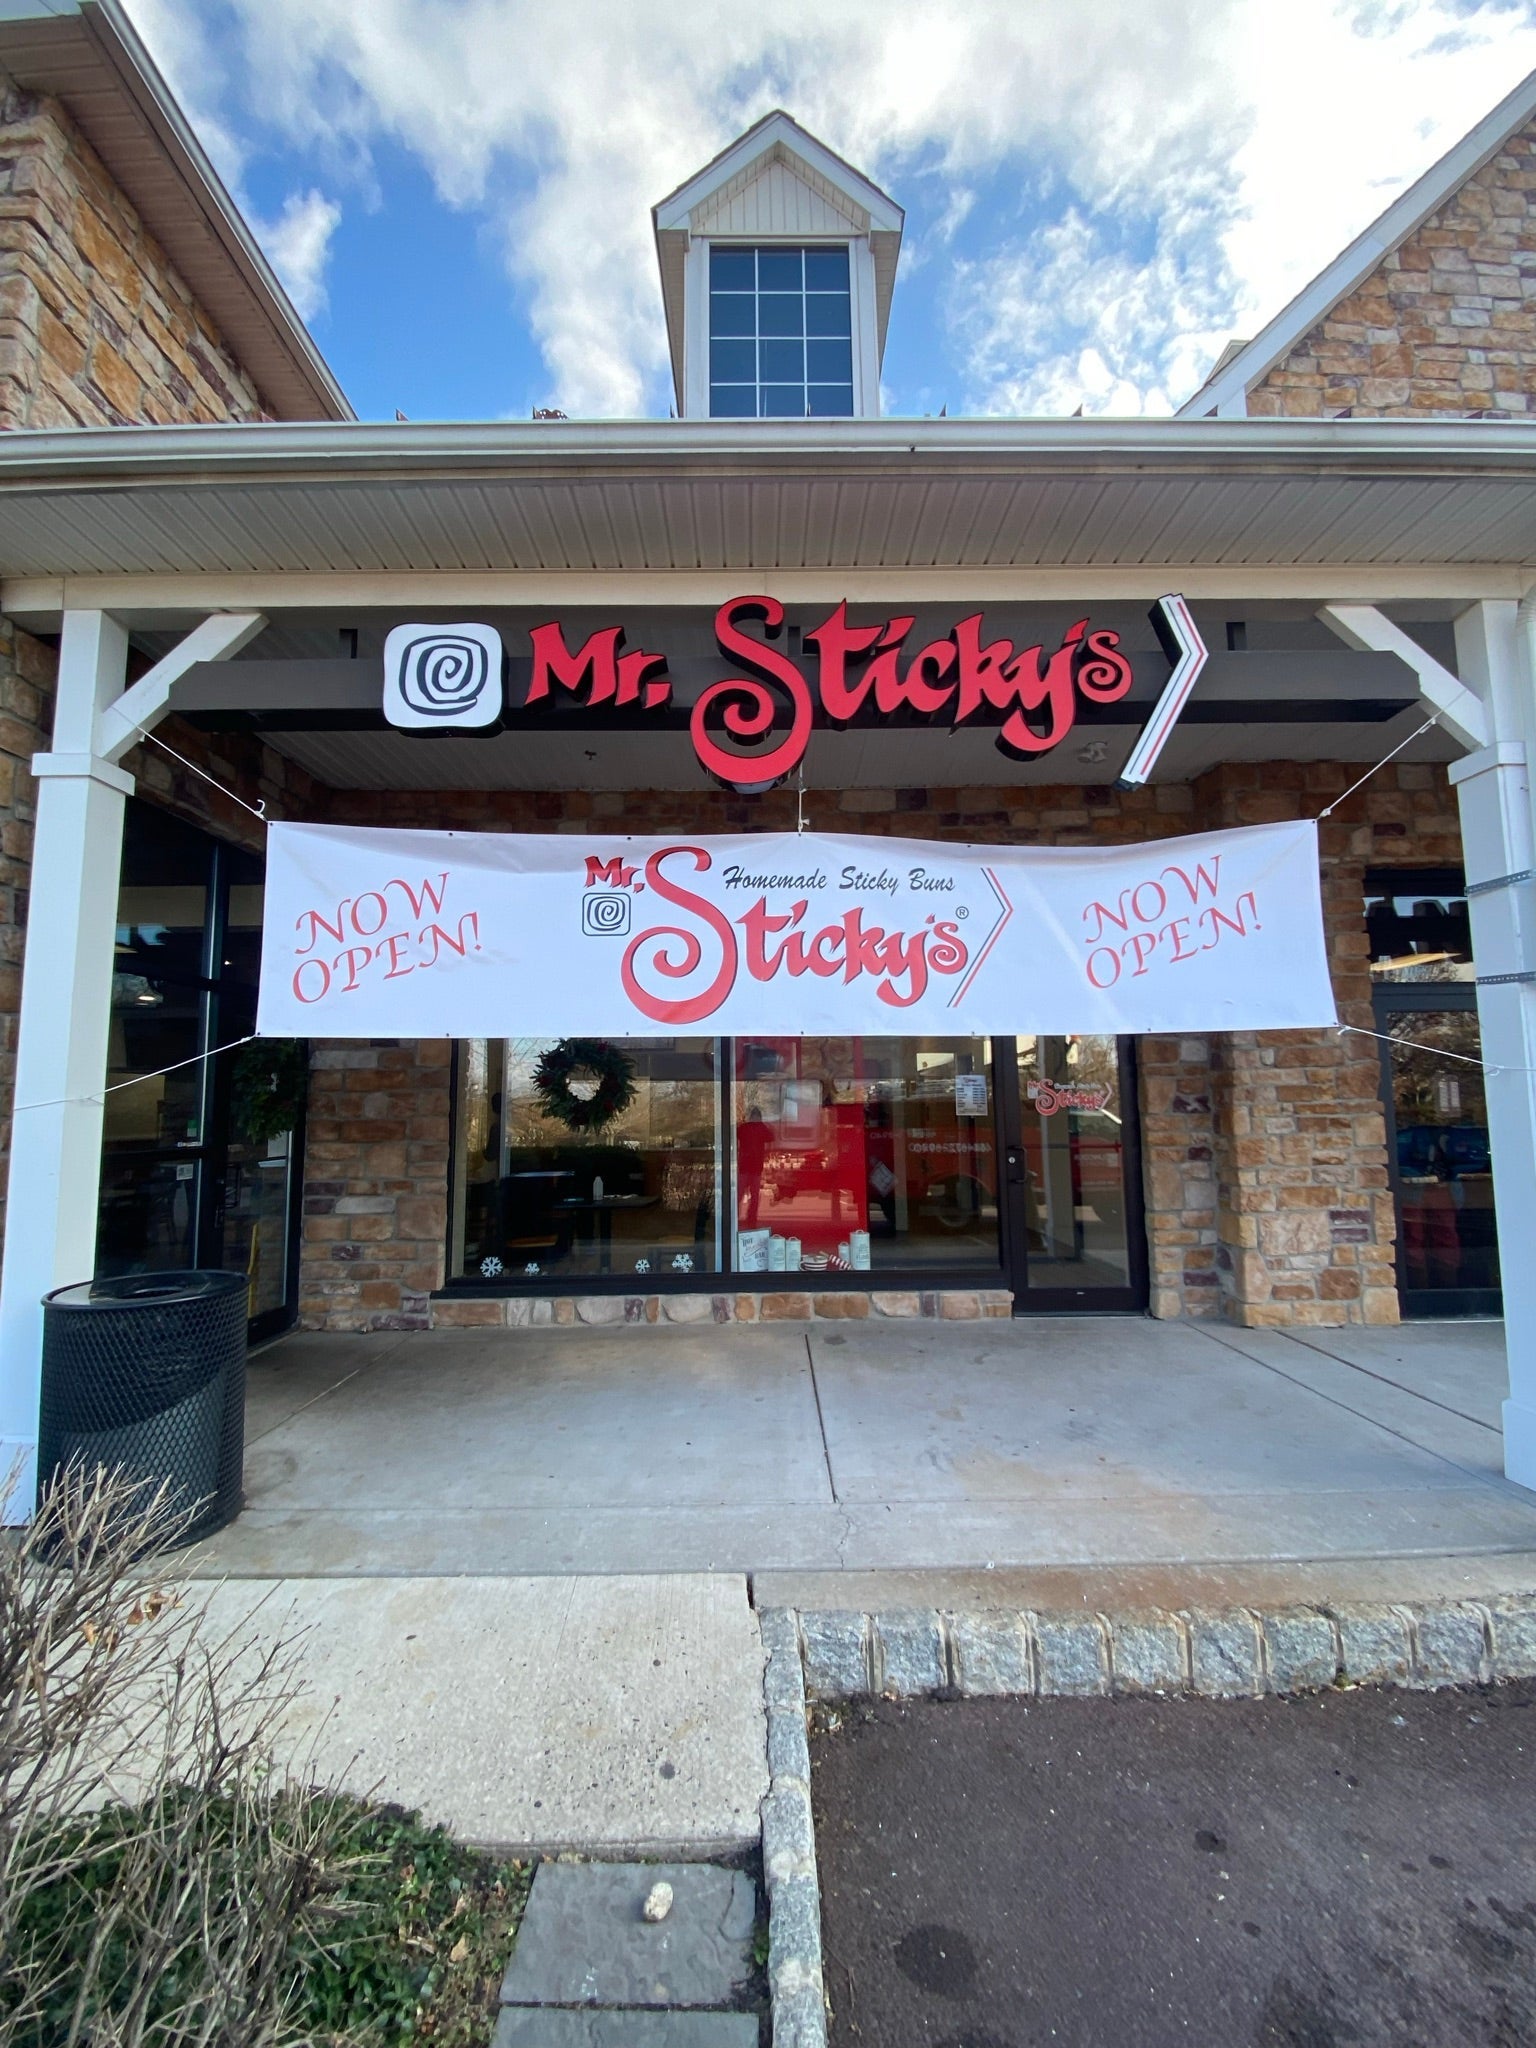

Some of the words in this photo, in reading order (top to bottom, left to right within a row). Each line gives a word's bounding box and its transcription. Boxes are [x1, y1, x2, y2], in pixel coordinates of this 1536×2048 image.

[524, 620, 673, 708] Mr.
[690, 595, 1133, 784] Sticky's
[294, 872, 450, 954] NOW
[583, 855, 646, 893] Mr.
[722, 865, 827, 890] Homemade
[839, 865, 899, 896] Sticky
[908, 868, 955, 892] Buns
[1083, 854, 1222, 943] NOW
[292, 911, 483, 1003] OPEN!
[620, 845, 968, 1024] Sticky's
[1086, 891, 1262, 988] OPEN!
